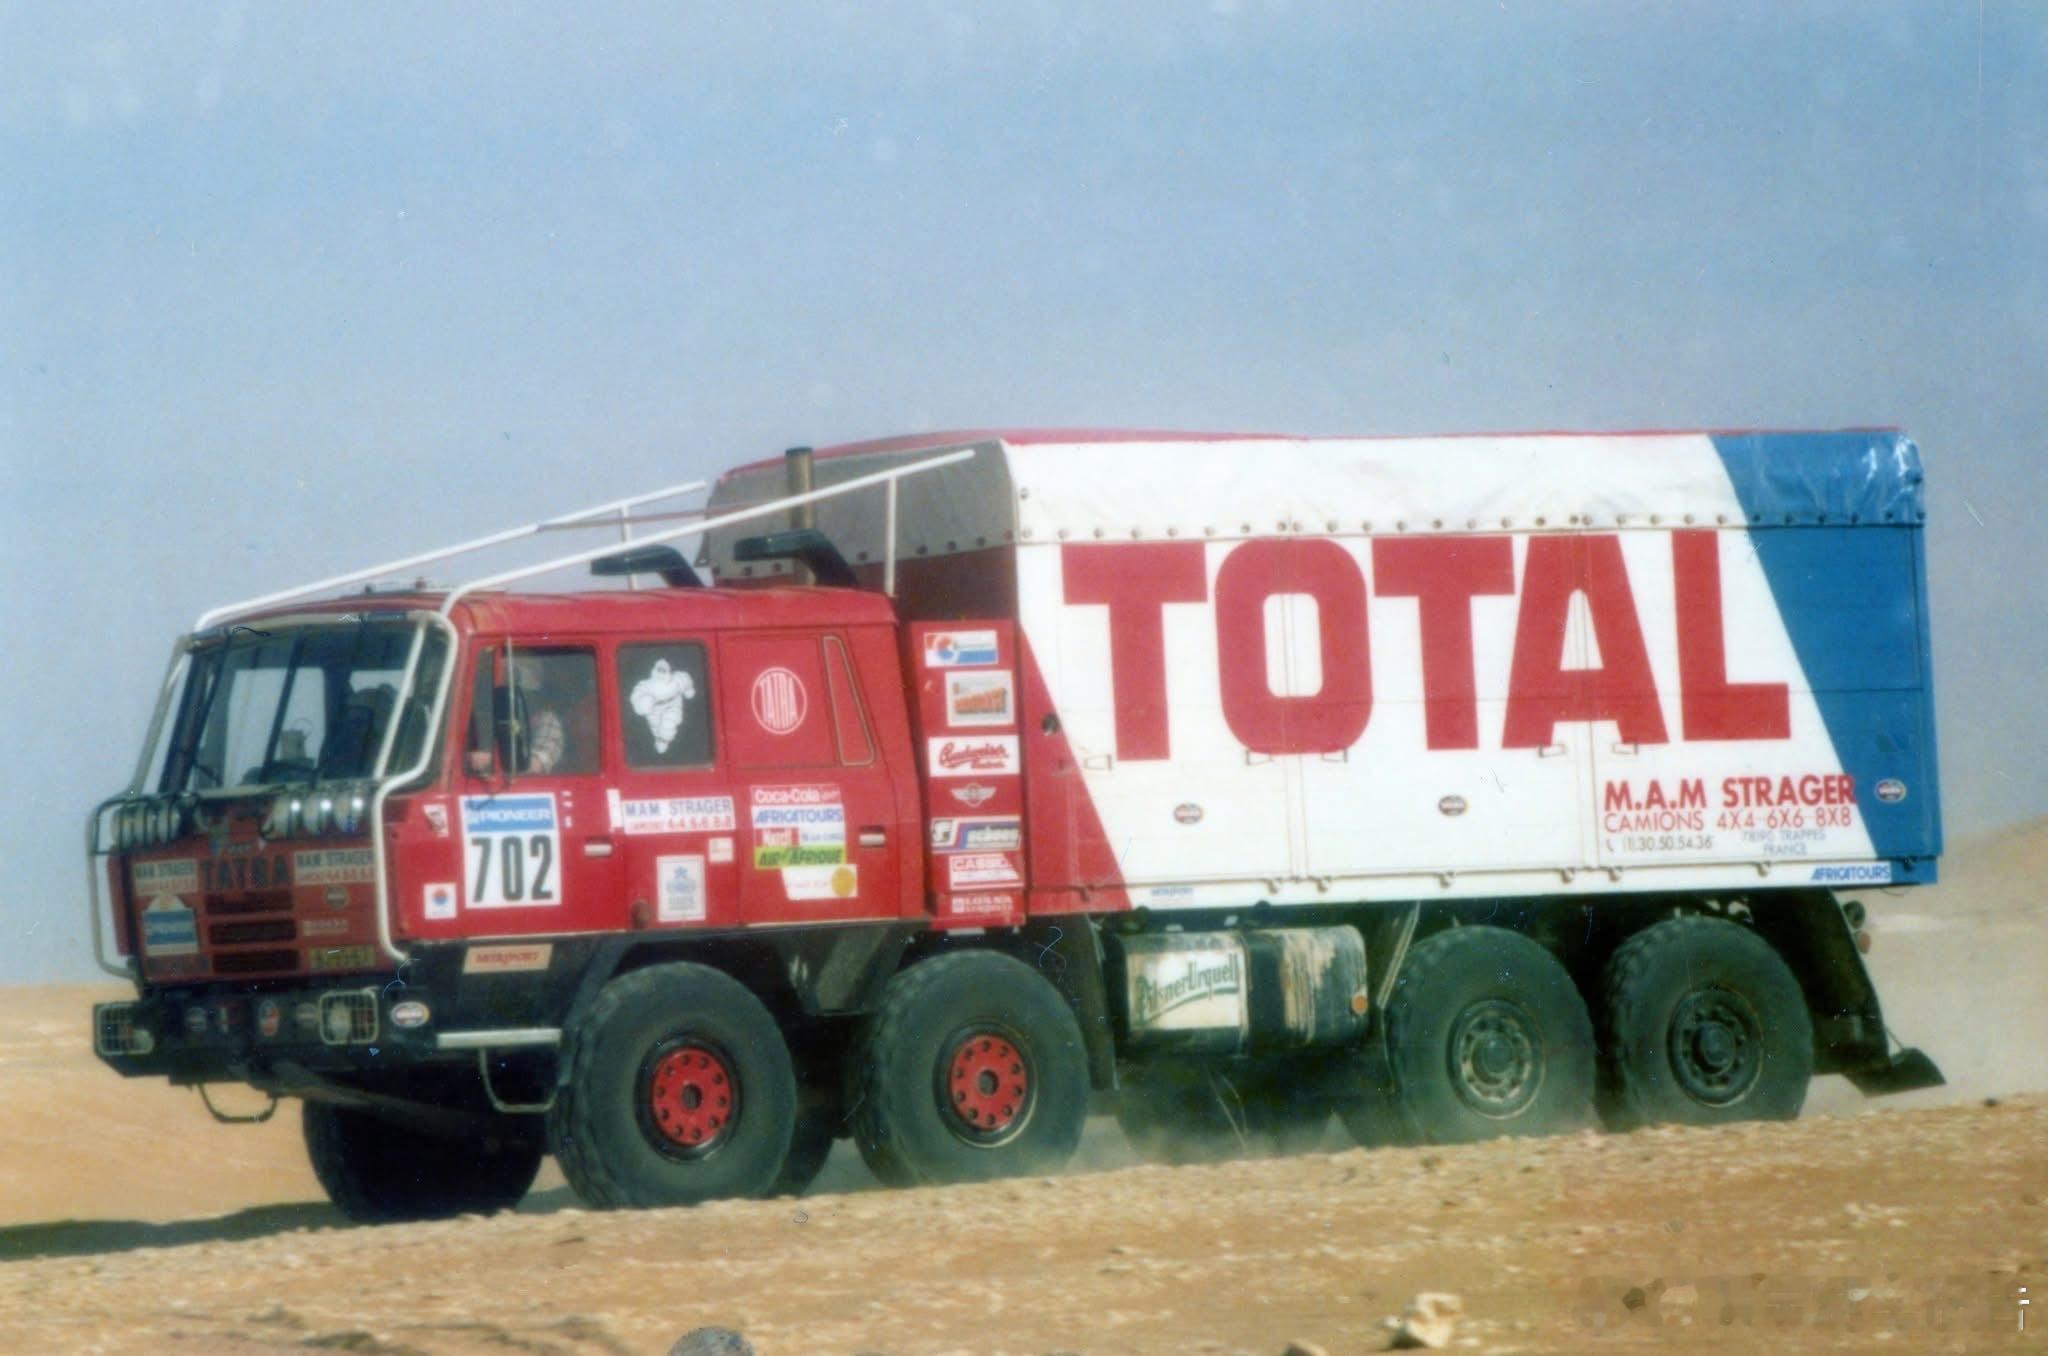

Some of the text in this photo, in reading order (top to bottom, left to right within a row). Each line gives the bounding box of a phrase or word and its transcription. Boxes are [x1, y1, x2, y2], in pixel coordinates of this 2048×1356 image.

[1060, 529, 1791, 761] TOTAL
[1604, 773, 1856, 812] M.A.M STRAGER
[481, 808, 551, 823] PIONEER
[669, 799, 732, 815] STRAGER
[1603, 811, 1705, 833] CAMIONS
[1815, 805, 1852, 827] 8X8
[471, 835, 553, 903] 702
[1811, 865, 1890, 881] AFRICATOURS
